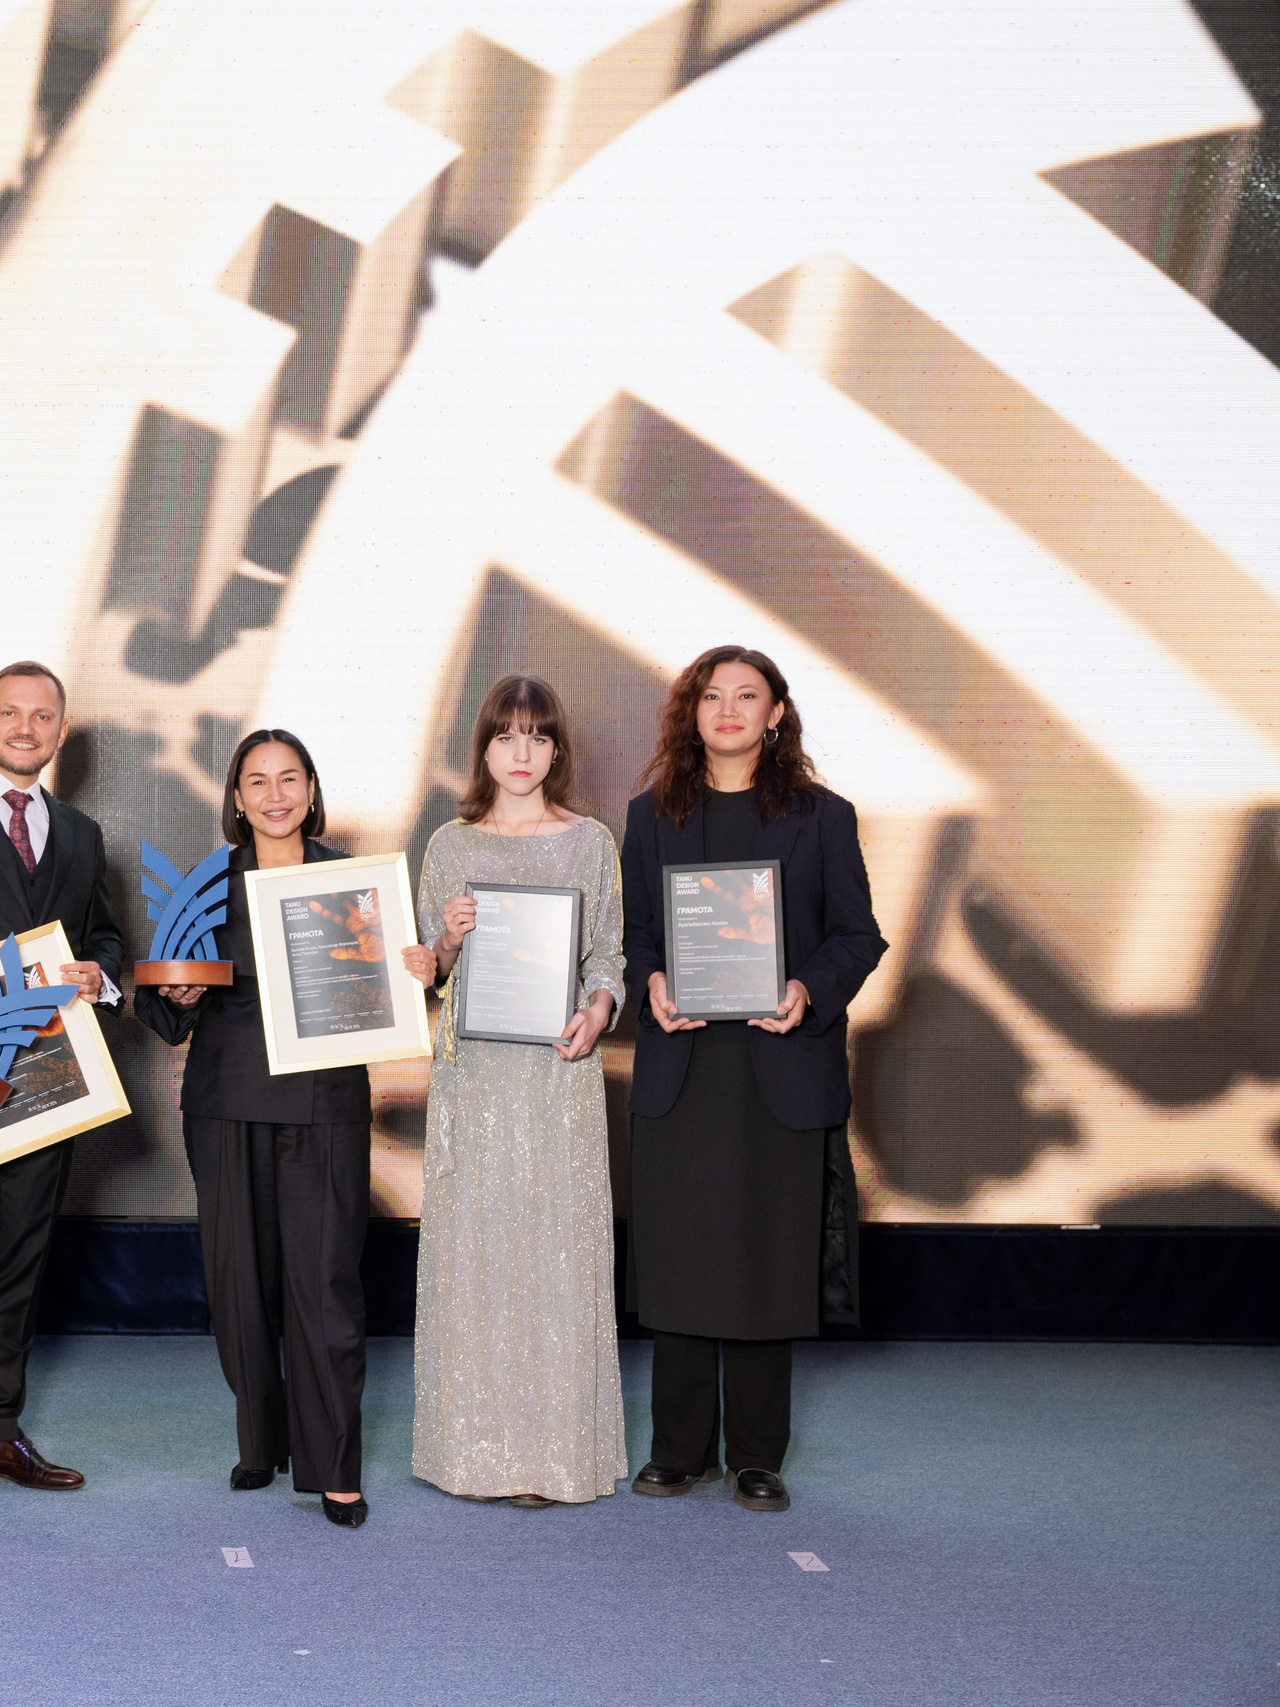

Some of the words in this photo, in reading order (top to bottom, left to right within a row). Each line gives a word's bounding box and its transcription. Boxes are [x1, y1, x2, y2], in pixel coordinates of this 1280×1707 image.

[677, 906, 713, 915] ГРАМОТА
[475, 924, 511, 934] ГРАМОТА
[289, 930, 323, 939] ГРАМОТА
